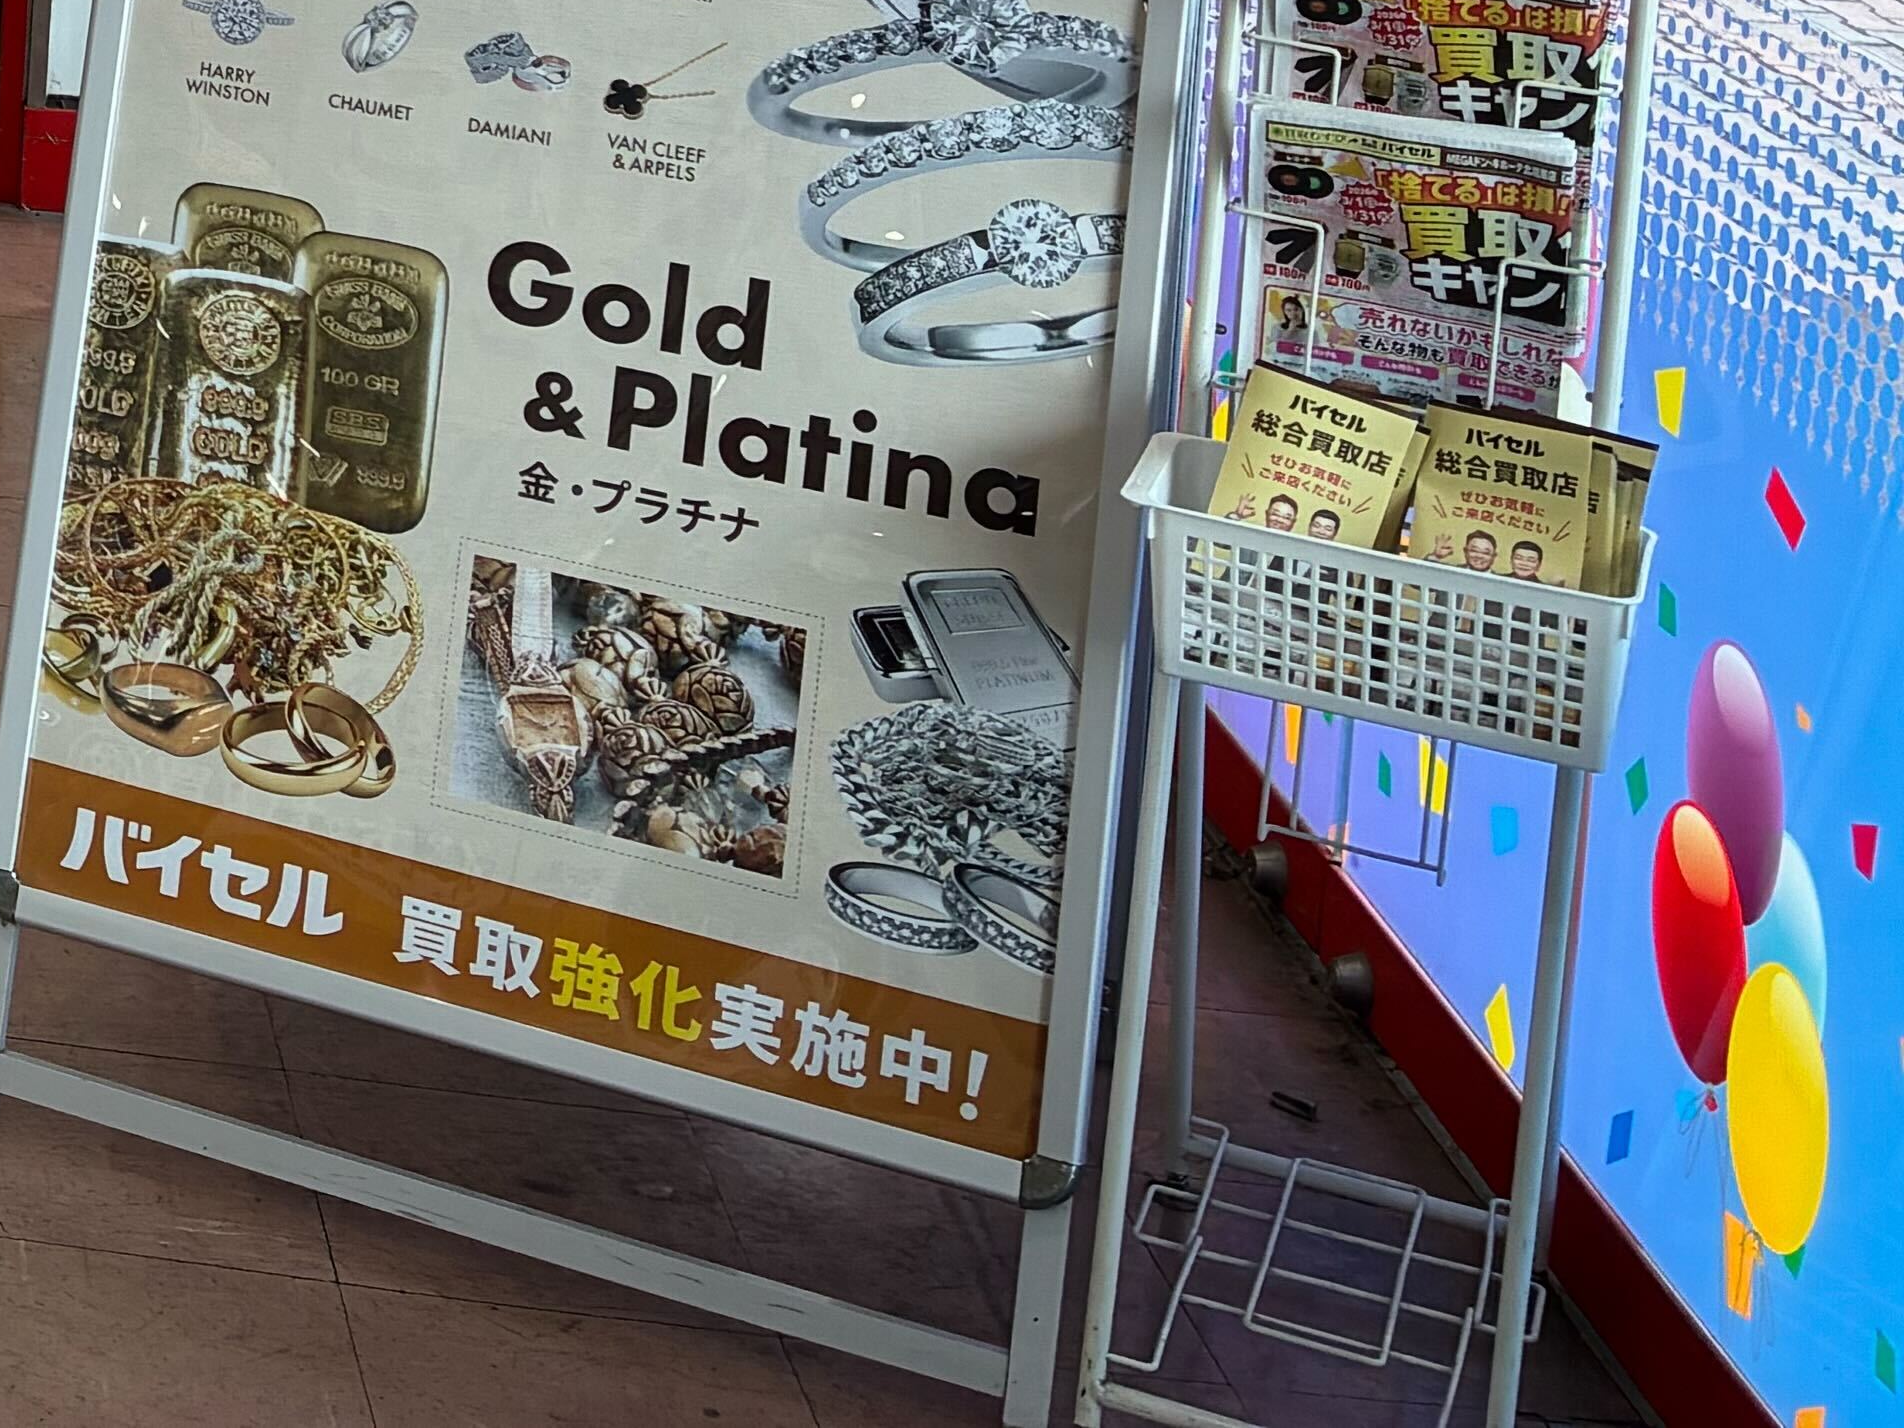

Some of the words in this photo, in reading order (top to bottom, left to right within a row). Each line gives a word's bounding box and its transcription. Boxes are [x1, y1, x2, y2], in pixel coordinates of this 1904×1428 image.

[200, 62, 255, 86] HARRY
[1429, 28, 1582, 87] 買取
[186, 79, 270, 107] WINSTON
[328, 94, 413, 122] CHAUMET
[468, 117, 551, 147] DAMIANI
[607, 134, 647, 156] VAN
[654, 140, 706, 165] CLEEF
[1380, 142, 1435, 159] バイセル
[629, 156, 696, 182] ARPELS
[1400, 205, 1553, 264] 買取
[487, 241, 771, 371] Gold
[321, 367, 359, 388] 100
[1289, 393, 1367, 433] バイセル
[195, 426, 267, 464] GOLD
[523, 371, 586, 440] &
[607, 366, 1040, 537] Platina
[1251, 409, 1393, 477] 総合買取店
[1465, 426, 1545, 459] バイセル
[1259, 466, 1352, 507] ご来店ください
[1270, 452, 1352, 490] ぜひお気軽に
[1434, 447, 1579, 499] 総合買取店
[517, 461, 760, 543] 金・プラチナ
[1451, 504, 1551, 535] ご来店ください
[1460, 489, 1545, 518] ぜひお気軽に
[59, 807, 344, 936] バイセル
[392, 894, 989, 1121] 買取強化実施中!
